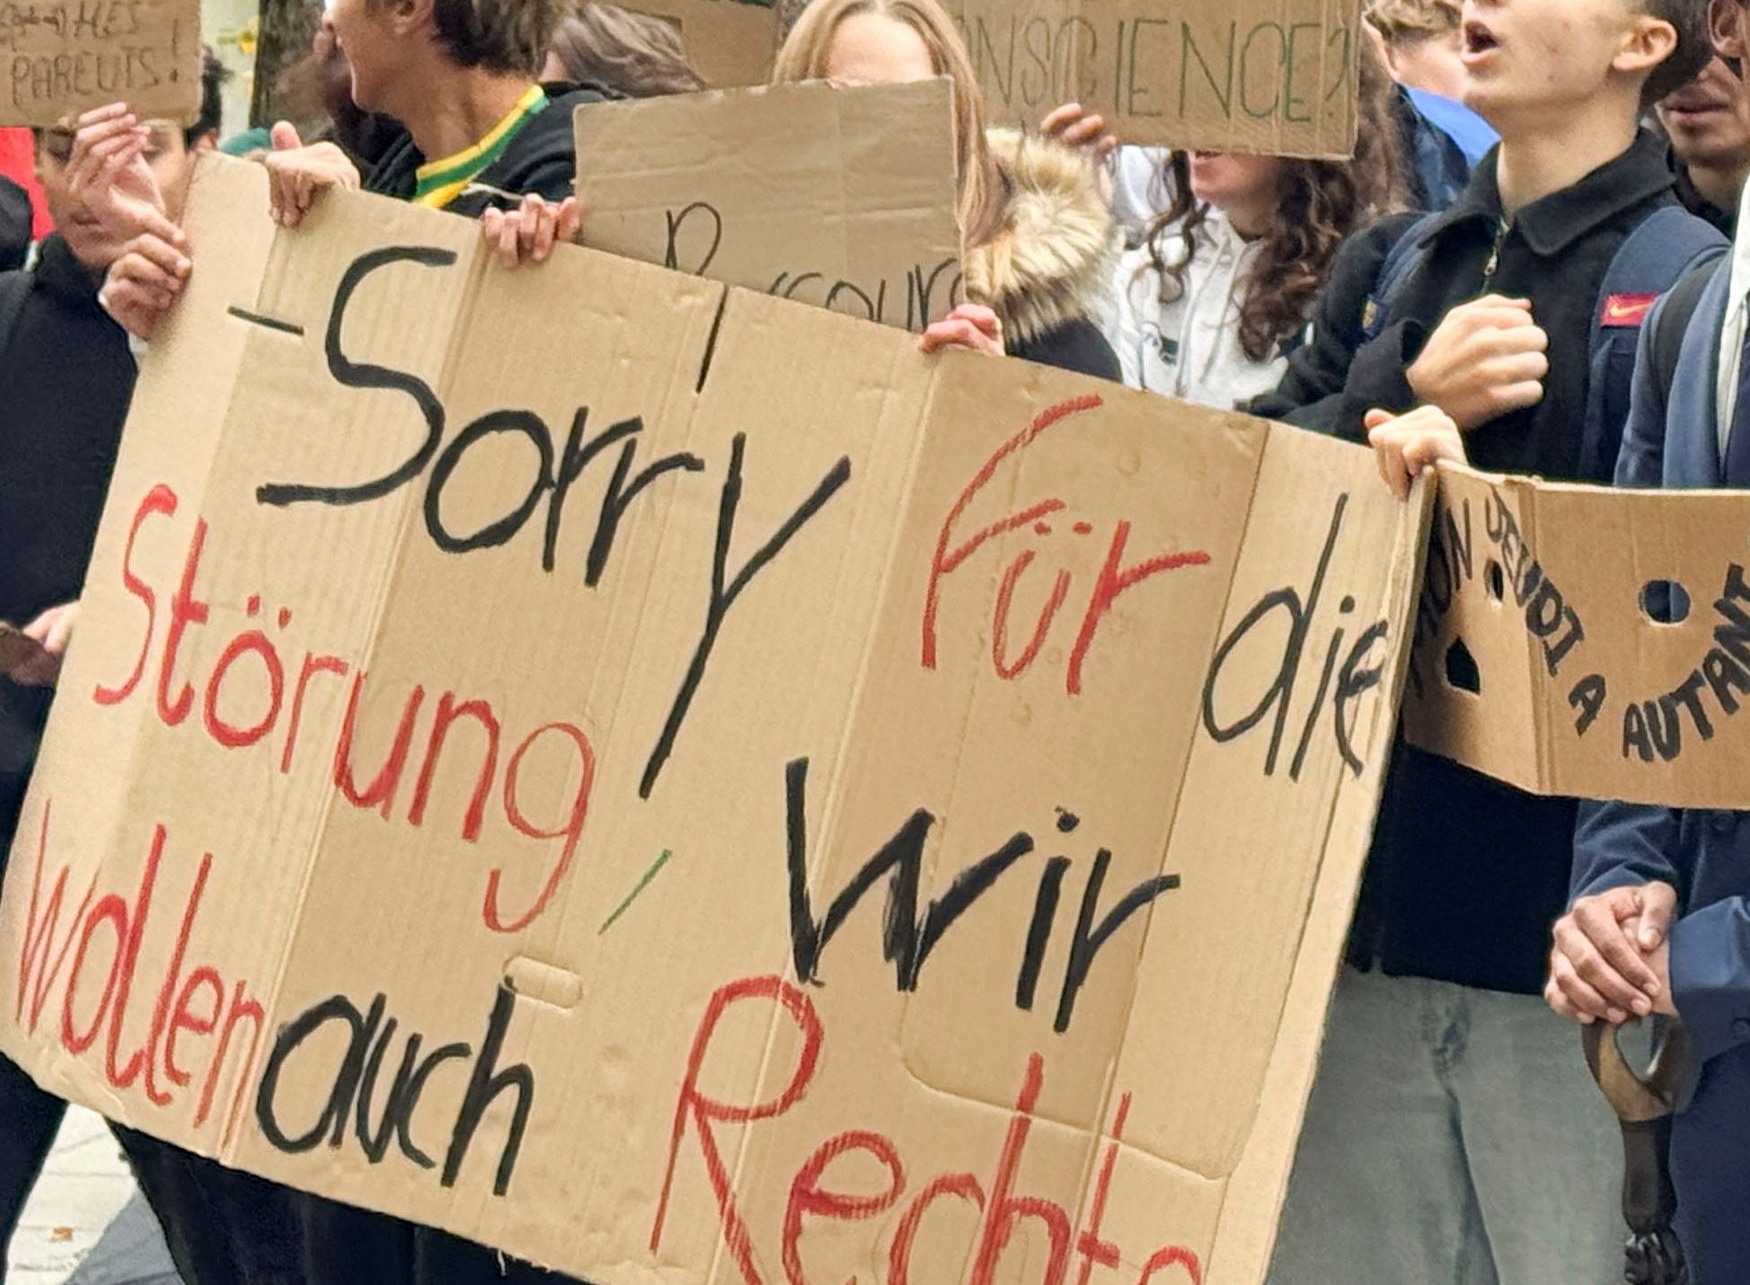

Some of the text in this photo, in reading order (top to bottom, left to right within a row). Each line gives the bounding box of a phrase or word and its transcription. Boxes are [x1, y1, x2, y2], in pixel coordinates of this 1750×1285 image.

[952, 15, 1350, 123] NSCIENCE?
[256, 245, 852, 799] Sorry
[1202, 492, 1390, 782] die
[1568, 674, 1607, 737] A
[786, 757, 1181, 1033] Wir
[256, 990, 535, 1198] auch
[650, 975, 1202, 1285] Recht
